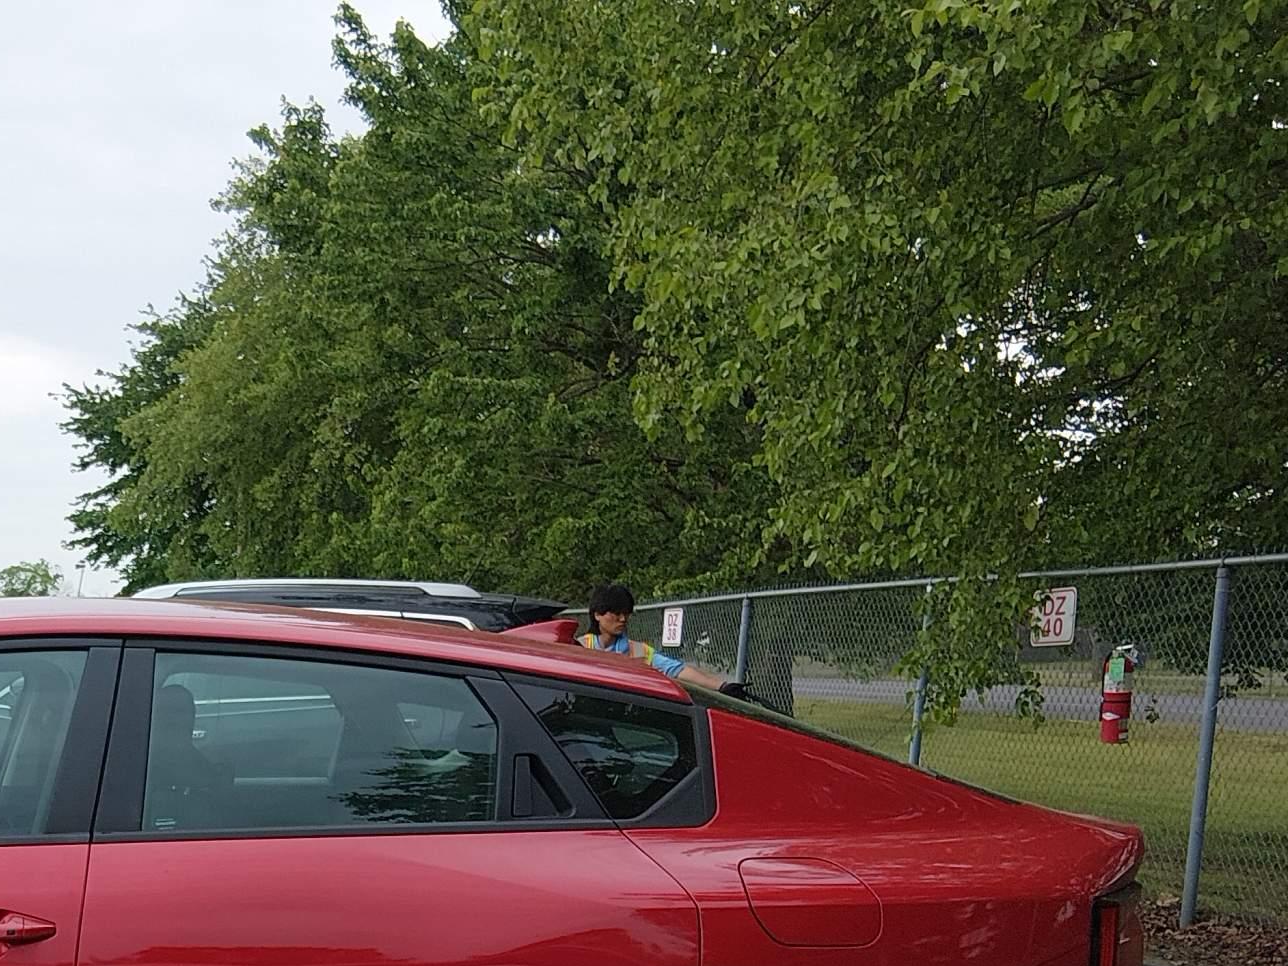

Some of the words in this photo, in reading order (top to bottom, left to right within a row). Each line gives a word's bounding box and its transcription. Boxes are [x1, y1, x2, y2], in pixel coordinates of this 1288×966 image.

[1043, 596, 1067, 617] DZ
[667, 613, 678, 627] DZ
[1042, 617, 1063, 637] 40
